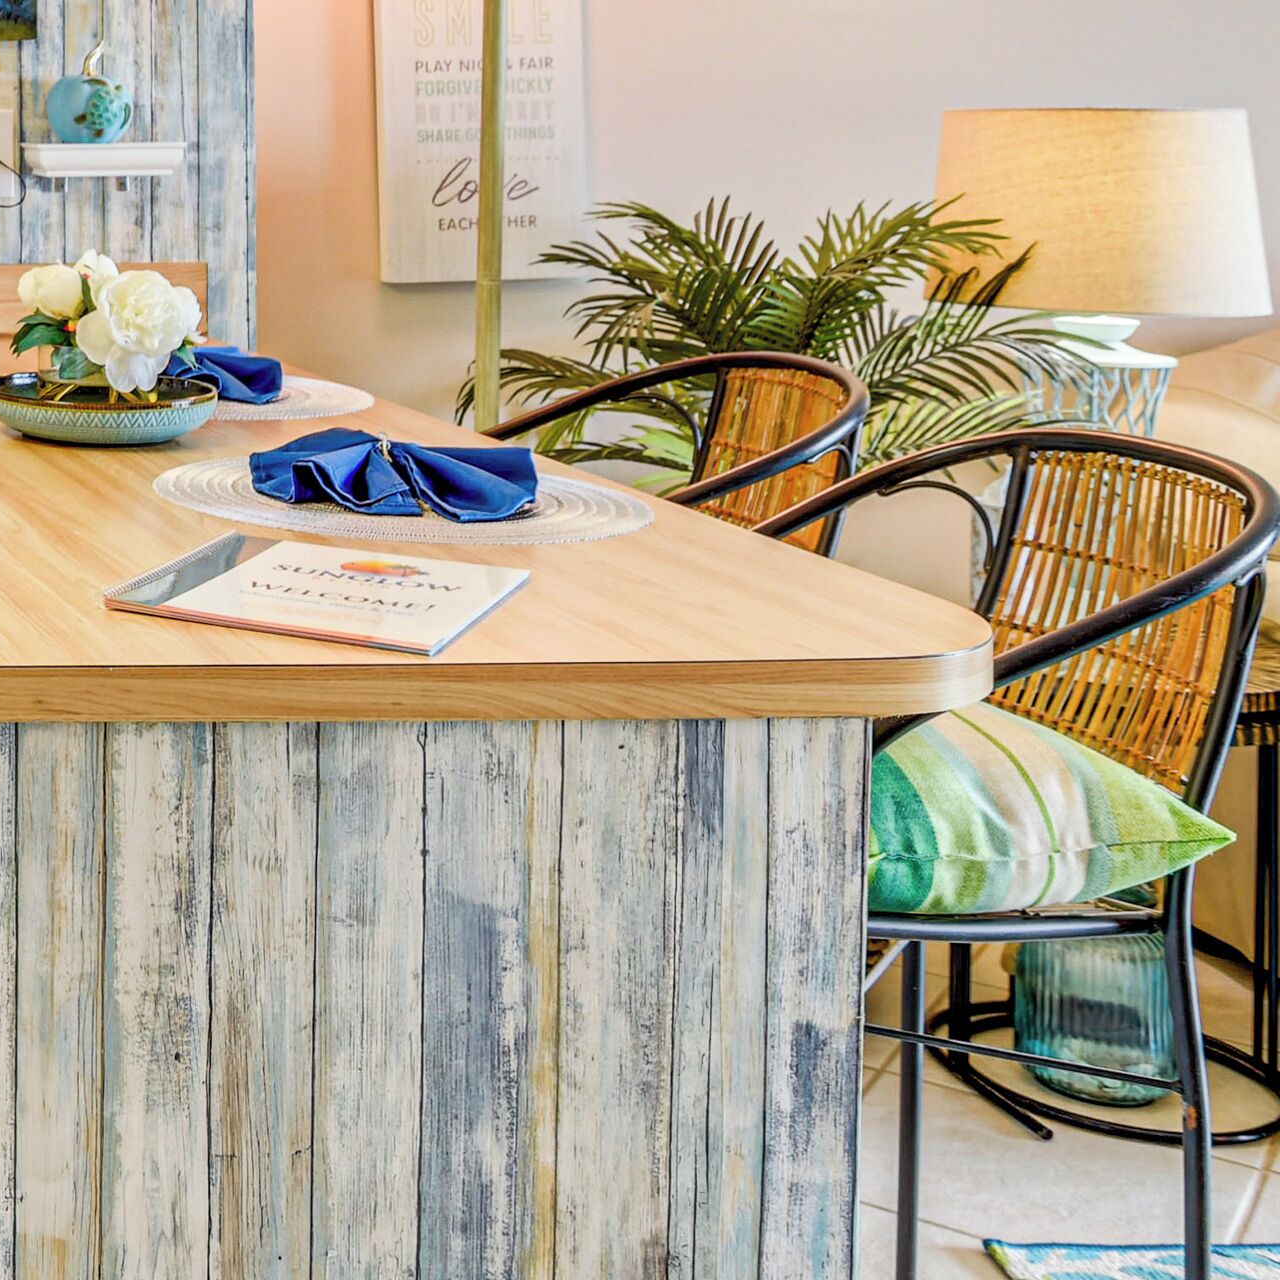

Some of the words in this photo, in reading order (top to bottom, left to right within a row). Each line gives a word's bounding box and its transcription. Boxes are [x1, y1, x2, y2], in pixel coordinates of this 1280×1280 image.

[415, 60, 452, 73] PLAY
[519, 57, 554, 69] FAIR
[416, 129, 463, 143] SHARE
[431, 156, 540, 207] loe
[272, 563, 462, 592] SUNGLOW
[251, 580, 438, 612] WELCOME!
